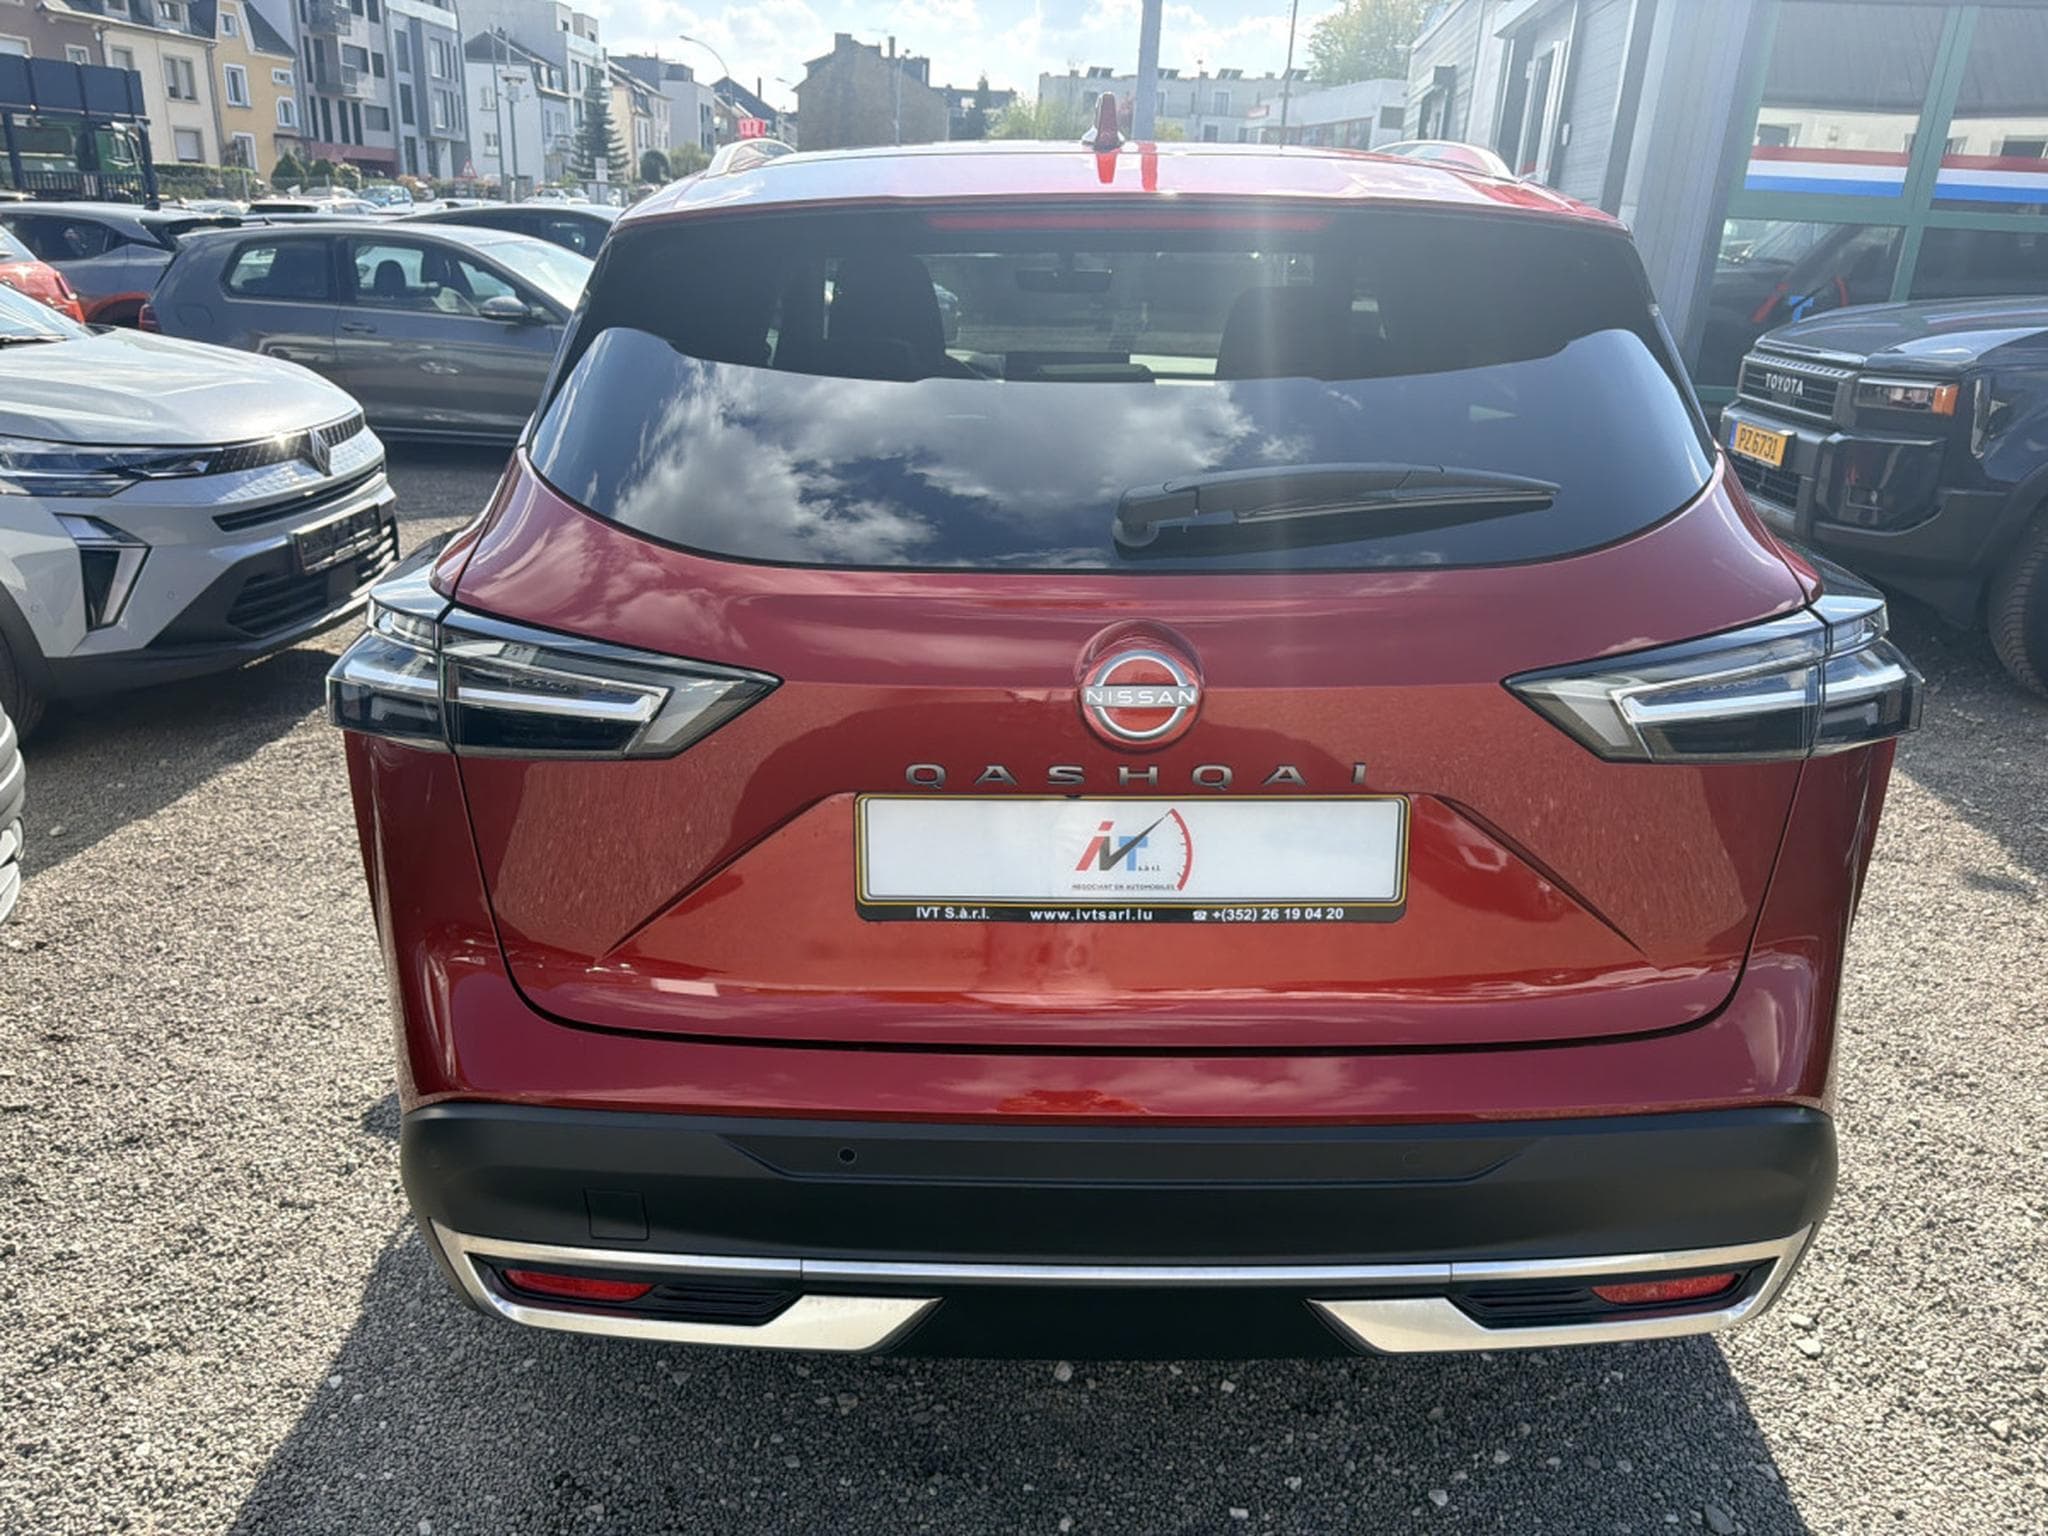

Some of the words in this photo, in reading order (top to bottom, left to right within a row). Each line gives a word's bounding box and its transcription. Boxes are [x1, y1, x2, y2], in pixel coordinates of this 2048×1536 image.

[1765, 373, 1803, 396] TOYOTA
[1086, 690, 1195, 704] NISSAN
[905, 763, 1368, 790] QASHQAI
[916, 906, 940, 919] IVT
[1030, 909, 1153, 921] www.ivtsarl.lu
[1261, 908, 1279, 920] 26
[1283, 908, 1301, 920] 19
[1304, 908, 1322, 919] 04
[1325, 907, 1344, 919] 20
